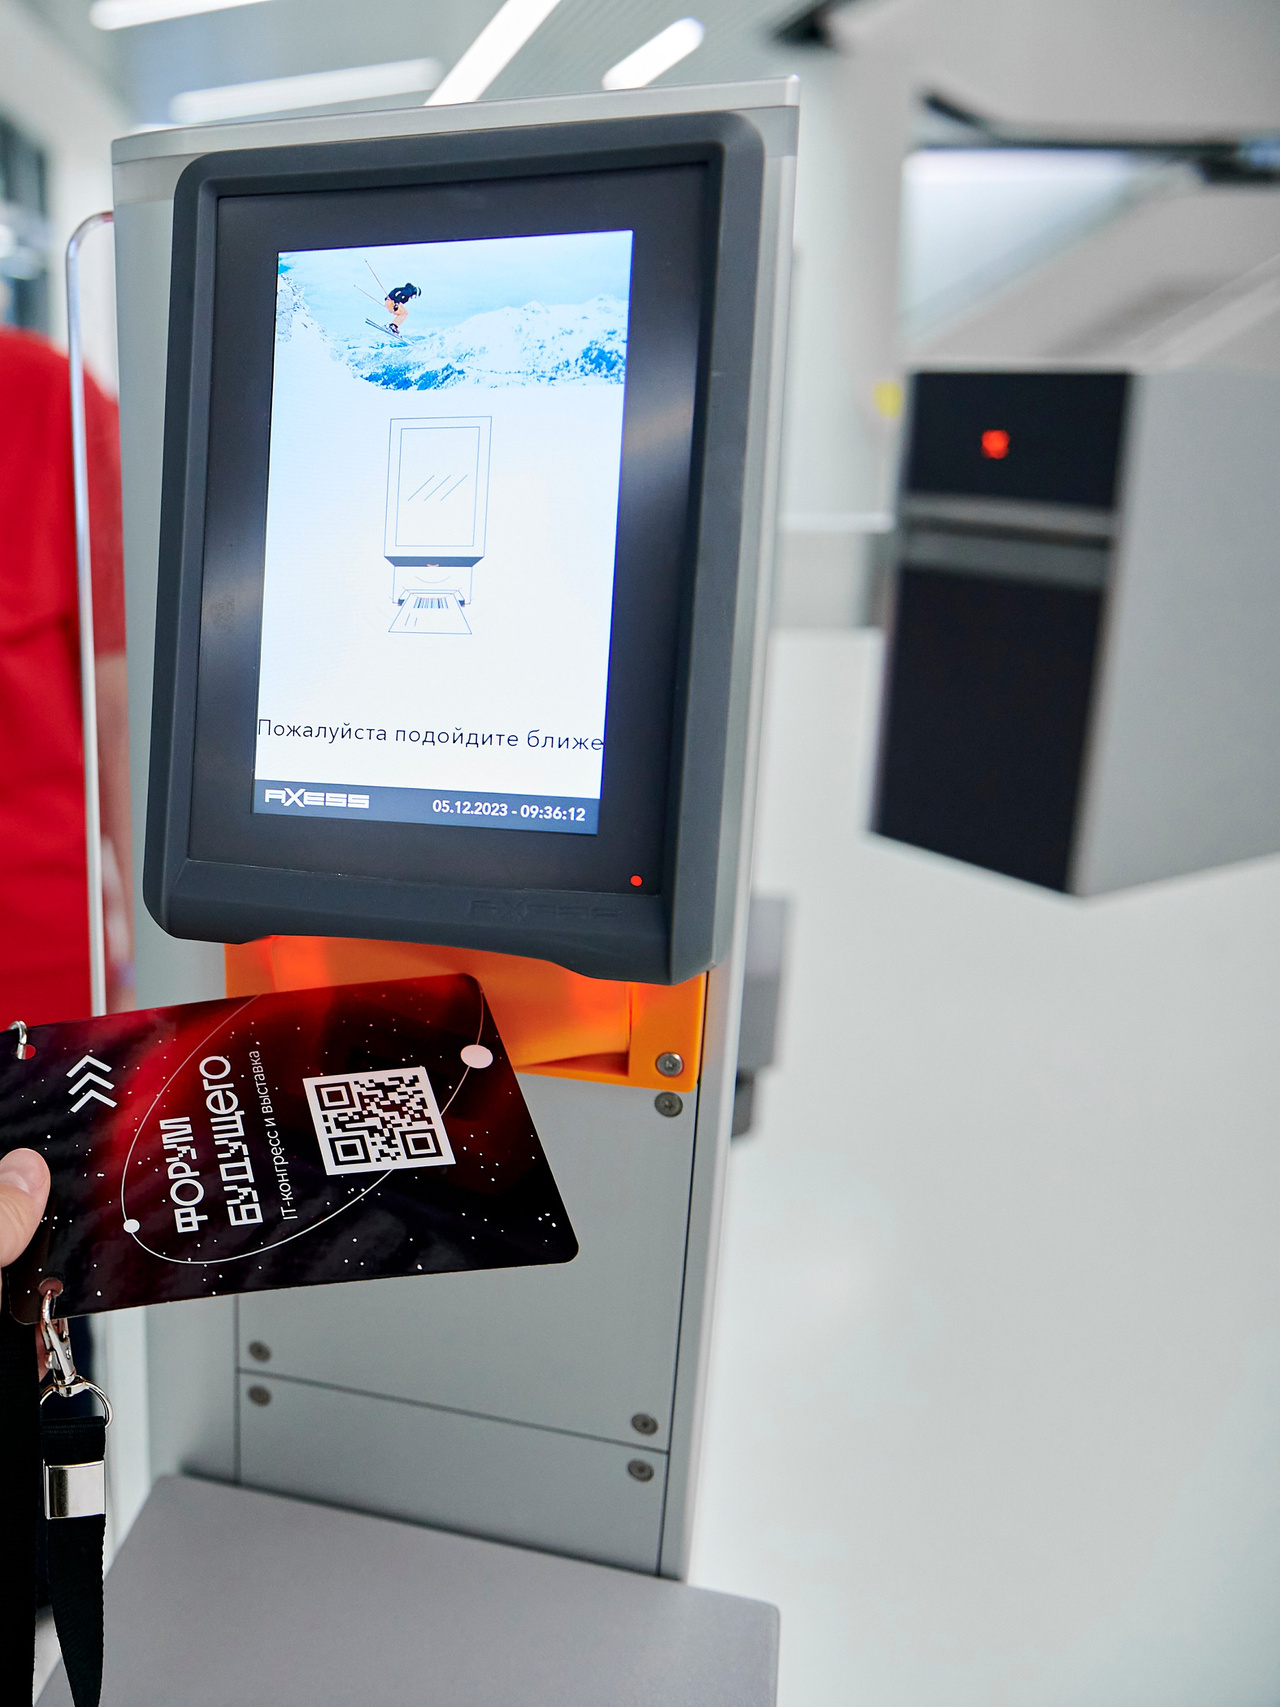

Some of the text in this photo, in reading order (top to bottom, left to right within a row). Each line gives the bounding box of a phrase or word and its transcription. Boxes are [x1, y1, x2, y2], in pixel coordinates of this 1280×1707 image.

[257, 718, 605, 751] Пожалуйста подойдите ближе
[264, 787, 370, 809] AXESS
[432, 799, 509, 817] 05.12.2023
[520, 804, 586, 822] 09:36:12
[249, 1050, 299, 1221] IT-конгресс и выставка
[159, 1116, 208, 1233] ФОРУМ
